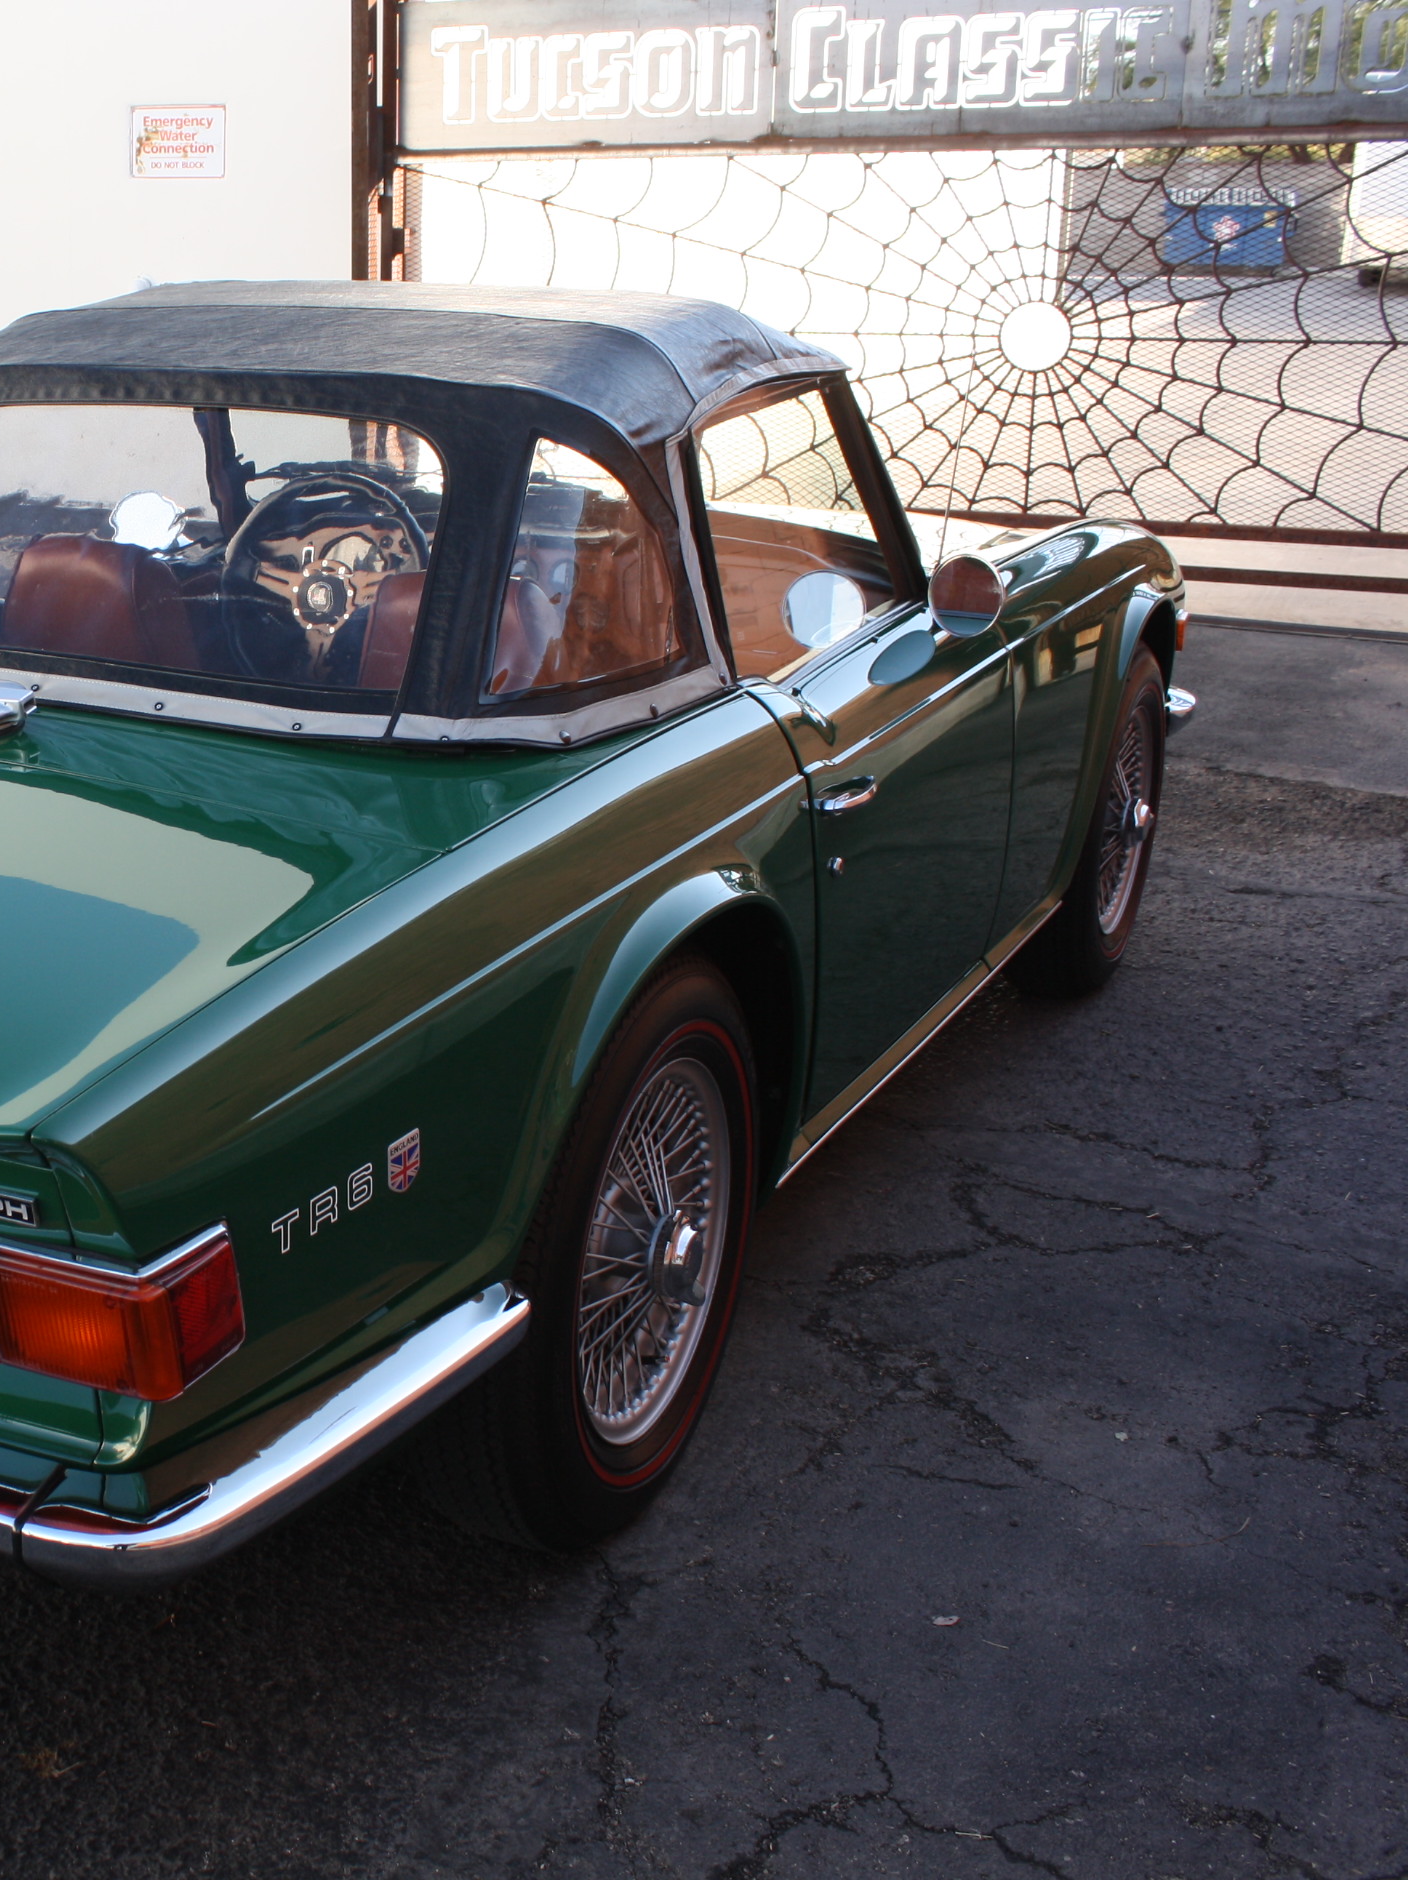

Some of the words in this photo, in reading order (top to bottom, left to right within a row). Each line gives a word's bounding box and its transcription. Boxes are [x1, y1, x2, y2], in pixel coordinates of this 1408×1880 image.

[431, 24, 761, 125] TUCSON
[789, 6, 1174, 114] CLASSIC
[143, 116, 214, 130] Emergency
[159, 130, 198, 142] Water
[143, 142, 215, 154] Connection
[151, 161, 162, 169] DO
[164, 161, 179, 169] NOT
[182, 161, 205, 169] BLOCK
[390, 1132, 419, 1156] ENGLAND
[271, 1162, 373, 1254] TR6
